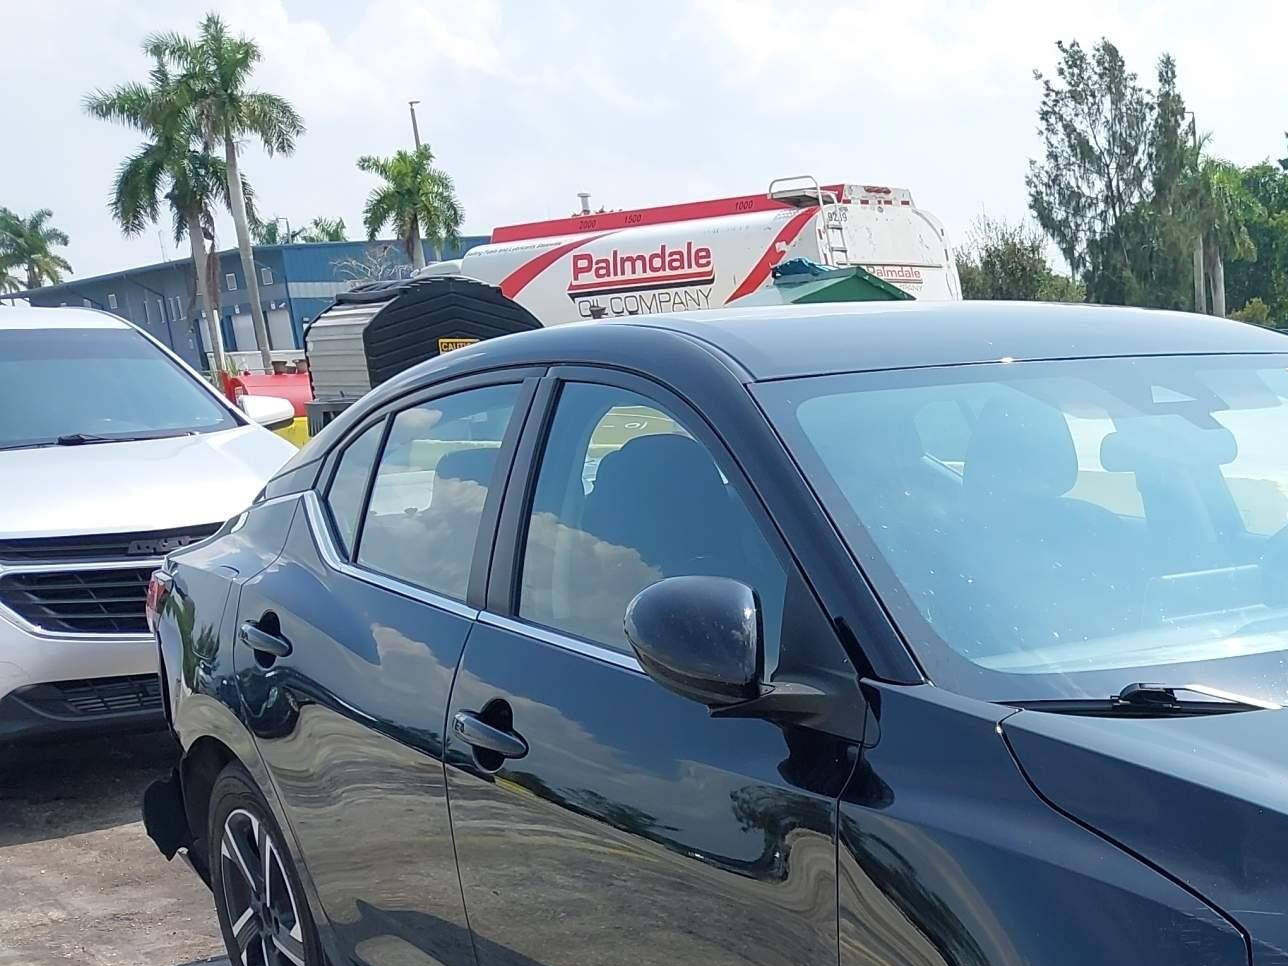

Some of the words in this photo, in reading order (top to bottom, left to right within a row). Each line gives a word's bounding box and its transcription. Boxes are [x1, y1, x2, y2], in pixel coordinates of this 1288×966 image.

[578, 219, 597, 230] 2000
[624, 214, 642, 224] 1500
[735, 200, 754, 211] 1000
[572, 241, 712, 281] Palmdale
[610, 287, 713, 315] COMPANY
